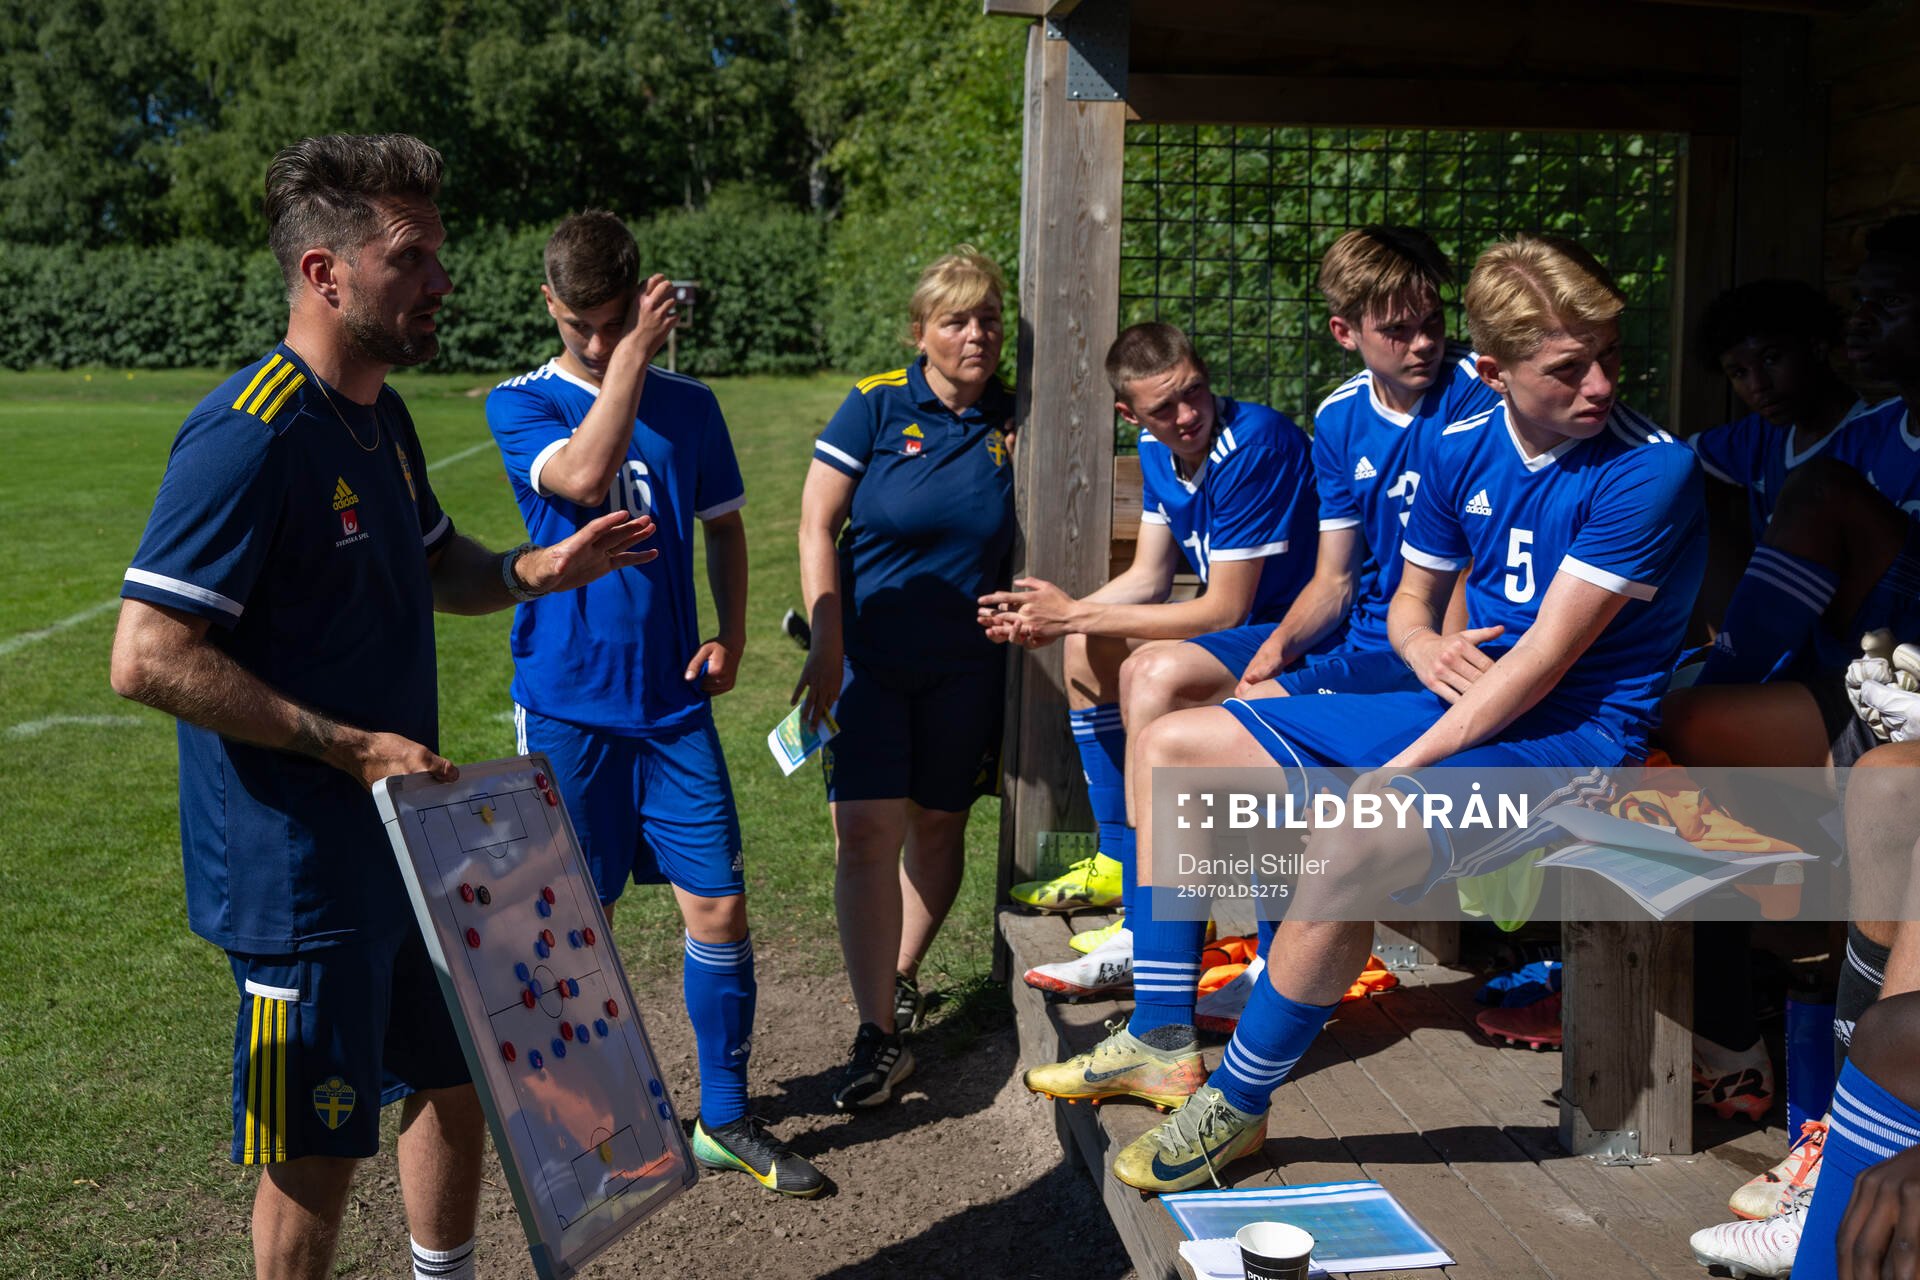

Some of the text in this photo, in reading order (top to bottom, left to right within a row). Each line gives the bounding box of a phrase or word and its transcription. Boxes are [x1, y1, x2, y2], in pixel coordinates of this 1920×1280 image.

[332, 494, 360, 511] adidas
[1465, 504, 1493, 516] adidas
[1504, 527, 1536, 604] 5
